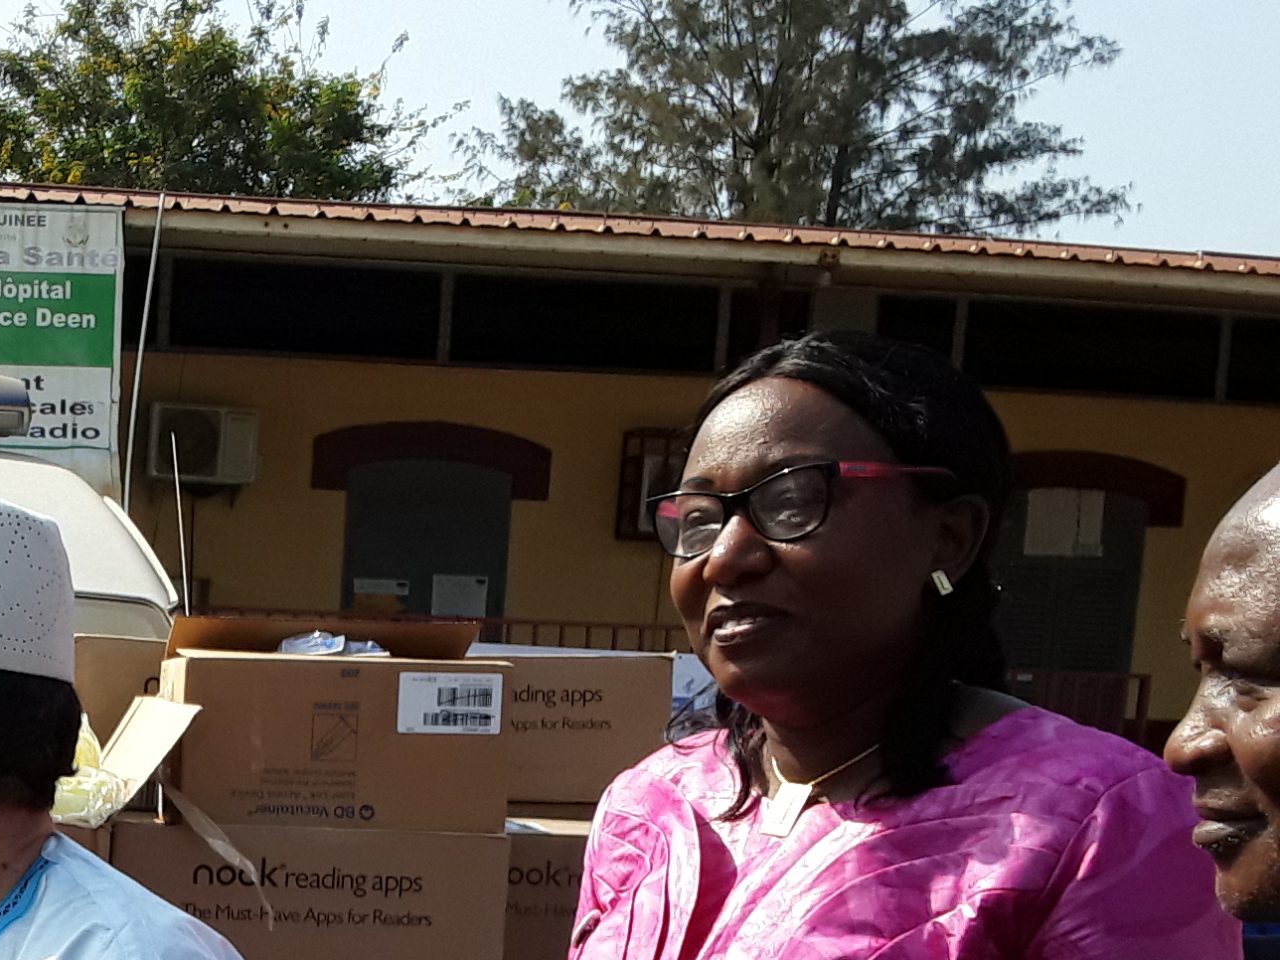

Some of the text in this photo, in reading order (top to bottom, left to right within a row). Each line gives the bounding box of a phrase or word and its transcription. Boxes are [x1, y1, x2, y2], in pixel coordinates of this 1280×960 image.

[22, 243, 119, 268] Santé
[35, 307, 96, 329] Deen
[561, 688, 603, 708] apps
[541, 717, 559, 731] for
[562, 716, 612, 731] Readers
[334, 804, 356, 820] BD
[284, 867, 368, 898] reading
[371, 872, 424, 898] apps
[303, 907, 344, 928] Apps
[347, 907, 368, 924] for
[372, 907, 433, 928] Readers
